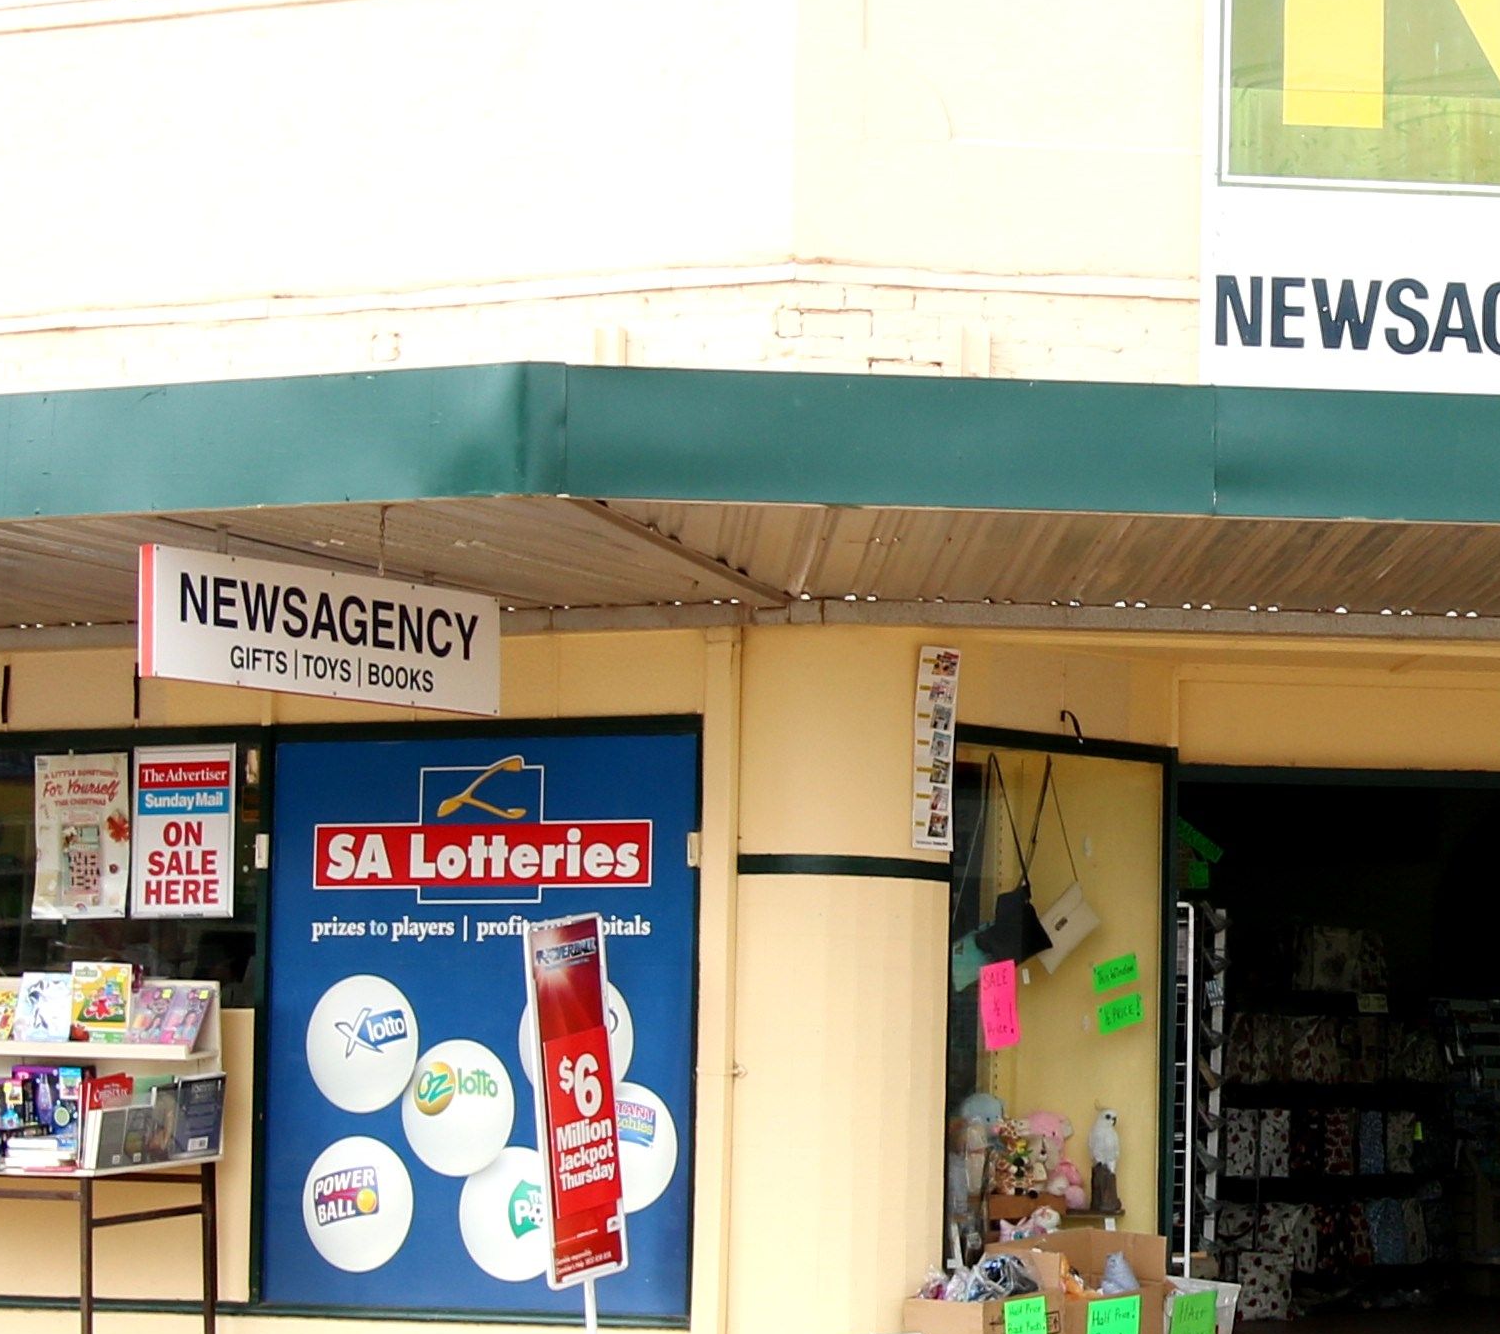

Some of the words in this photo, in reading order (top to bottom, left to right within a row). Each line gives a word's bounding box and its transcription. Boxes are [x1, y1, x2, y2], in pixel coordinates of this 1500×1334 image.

[180, 571, 479, 661] NEWSAGENCY
[230, 645, 288, 675] GIFTS
[302, 653, 352, 683] TOYS
[367, 662, 434, 693] BOOKS
[141, 768, 166, 783] The
[165, 766, 227, 782] Advertiser
[43, 780, 64, 798] For
[67, 778, 121, 803] Yourself
[144, 793, 195, 811] Sunday
[195, 792, 224, 806] Mail
[163, 820, 203, 847] ON
[147, 849, 218, 877] SALE
[326, 833, 393, 881] SA
[409, 827, 640, 879] Lotteries
[145, 879, 220, 906] HERE
[311, 916, 366, 942] prizes
[369, 917, 388, 937] to
[391, 915, 455, 942] players
[982, 968, 1008, 991] SALE
[457, 1067, 499, 1098] lotto
[558, 1052, 603, 1118] $6
[617, 1102, 655, 1124] TANT
[556, 1118, 613, 1152] Million
[558, 1139, 614, 1173] Jackpot
[315, 1168, 376, 1199] POWER
[559, 1161, 615, 1192] Thursday
[317, 1198, 356, 1224] BALL
[1091, 1310, 1112, 1327] Half
